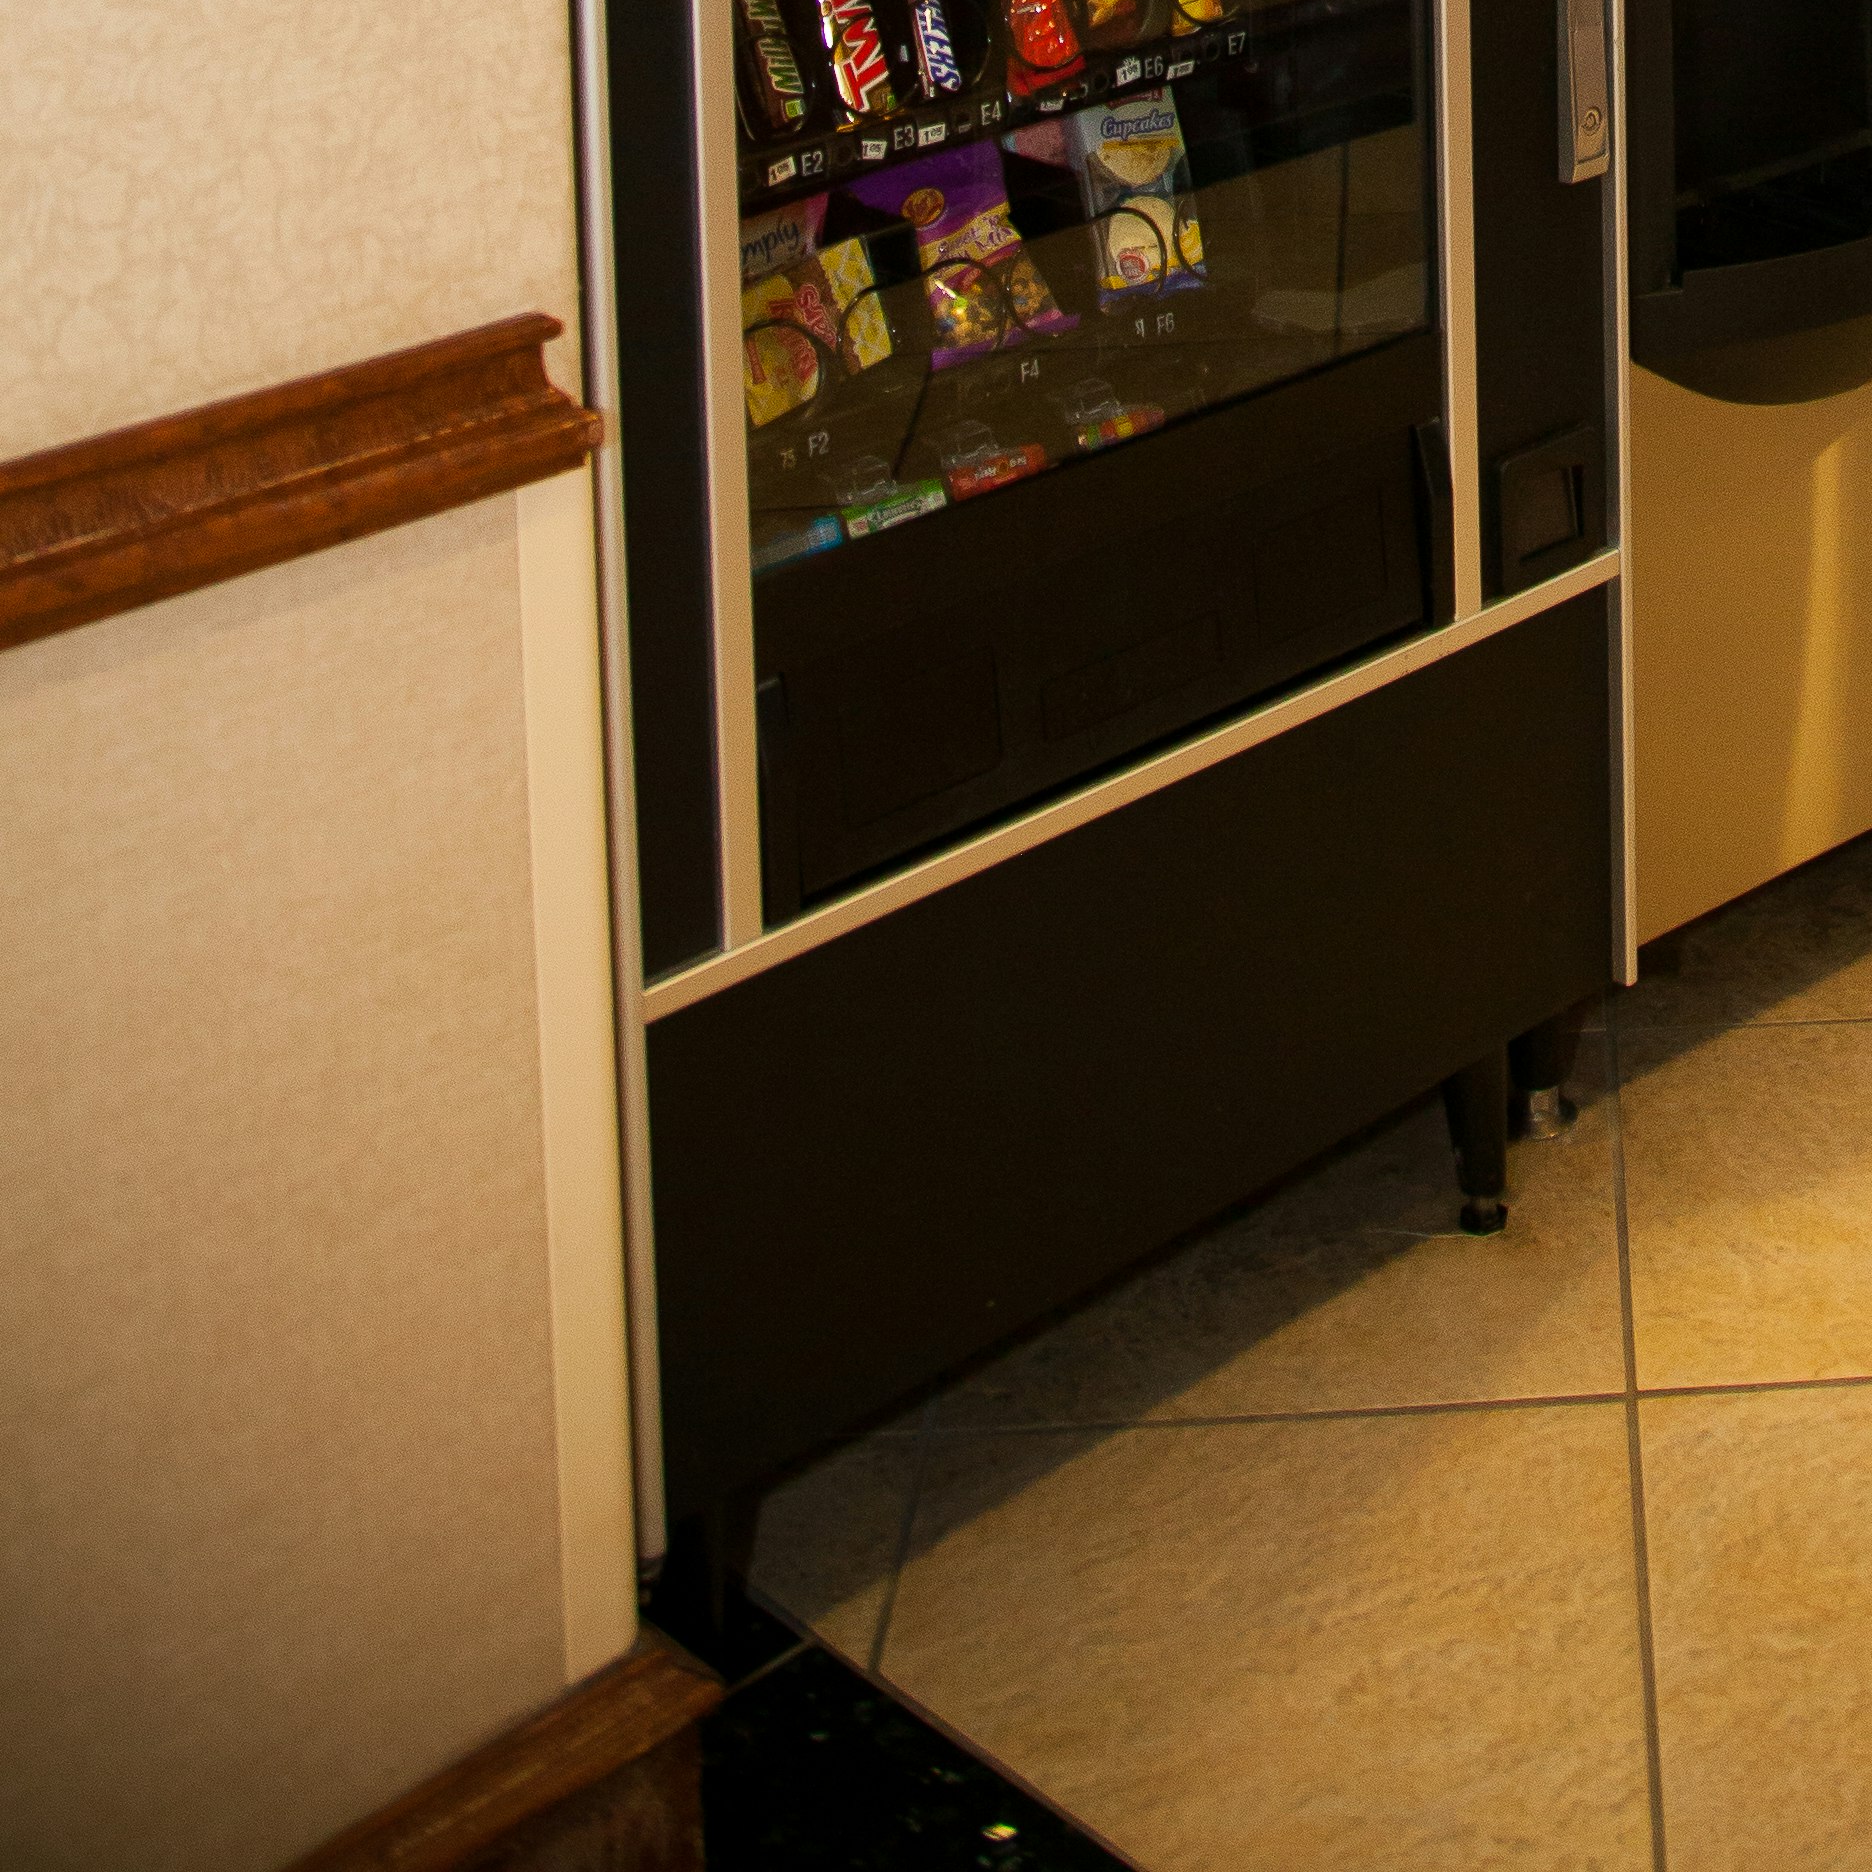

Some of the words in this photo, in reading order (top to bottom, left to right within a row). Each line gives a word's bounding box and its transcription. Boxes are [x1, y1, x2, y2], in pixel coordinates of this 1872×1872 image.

[1228, 31, 1245, 55] E7
[1144, 55, 1164, 79] E6
[981, 101, 1001, 126] E4
[1100, 108, 1176, 142] Cupcakes
[894, 124, 915, 150] E3
[801, 150, 823, 177] E2
[743, 215, 800, 265] mply
[1157, 312, 1175, 336] F6
[1020, 358, 1040, 383] F4
[808, 431, 830, 457] F2
